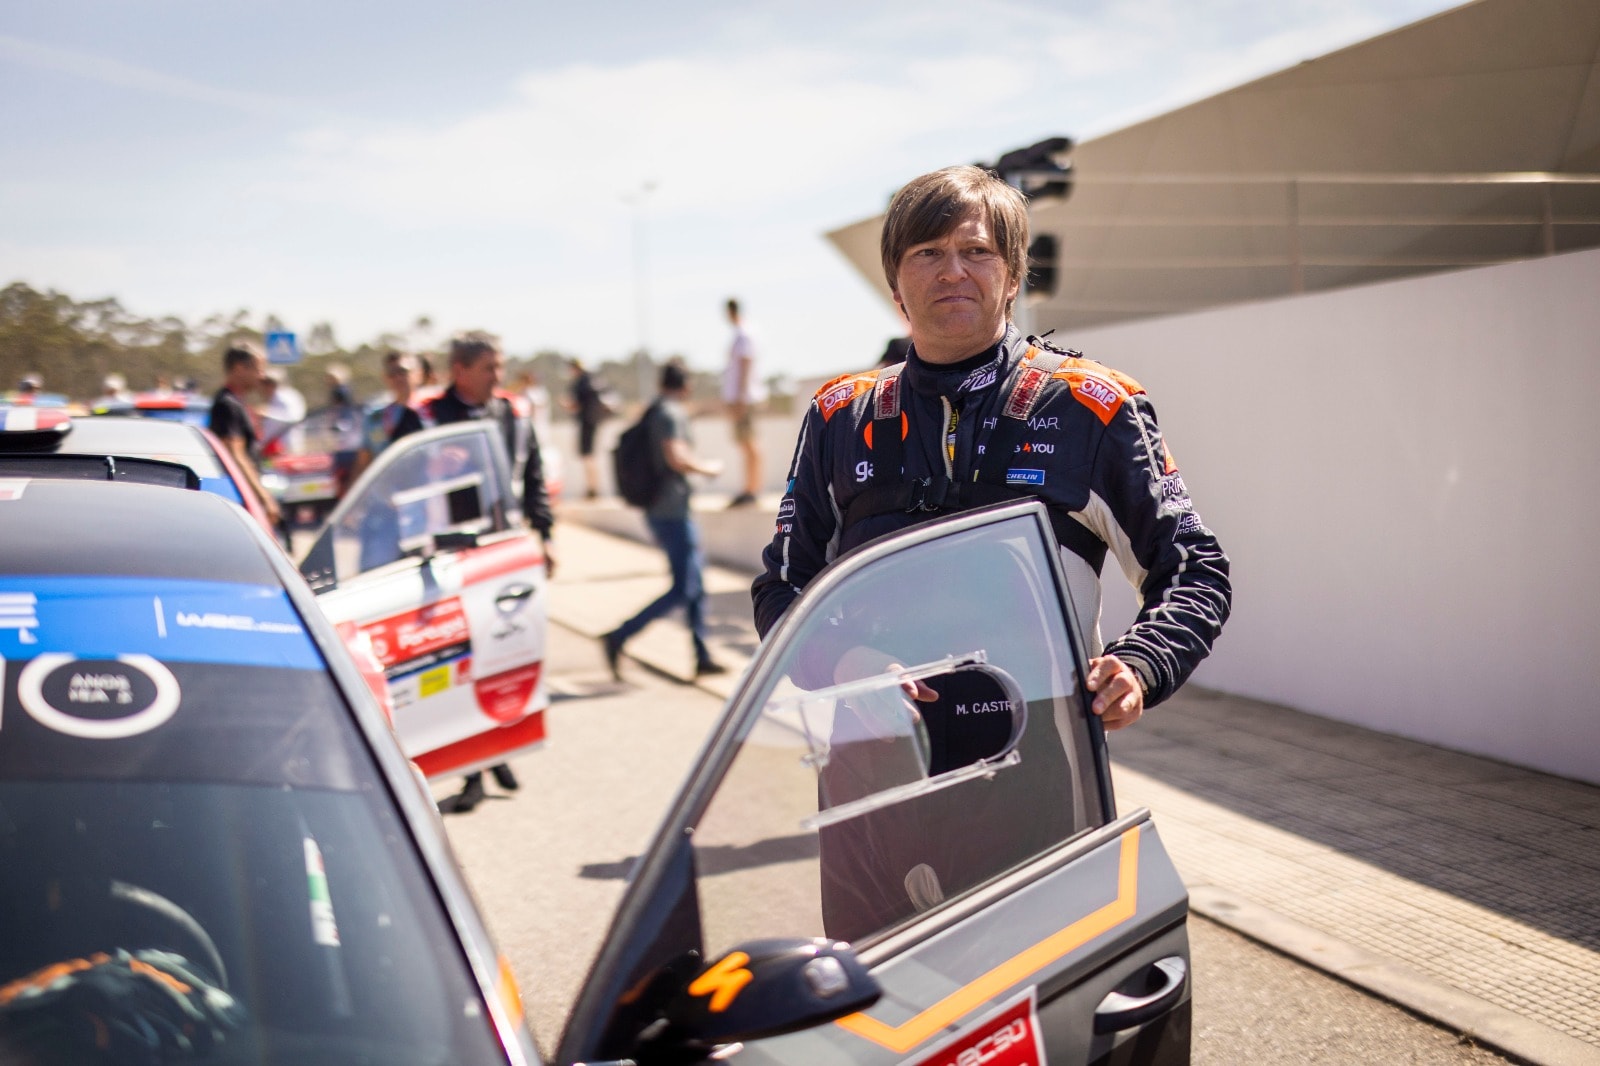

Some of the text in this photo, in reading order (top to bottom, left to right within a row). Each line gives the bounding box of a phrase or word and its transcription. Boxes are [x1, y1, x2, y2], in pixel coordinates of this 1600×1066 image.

[1080, 379, 1117, 405] OMP
[1006, 472, 1038, 480] CHELIN
[972, 700, 1014, 714] CASTR
